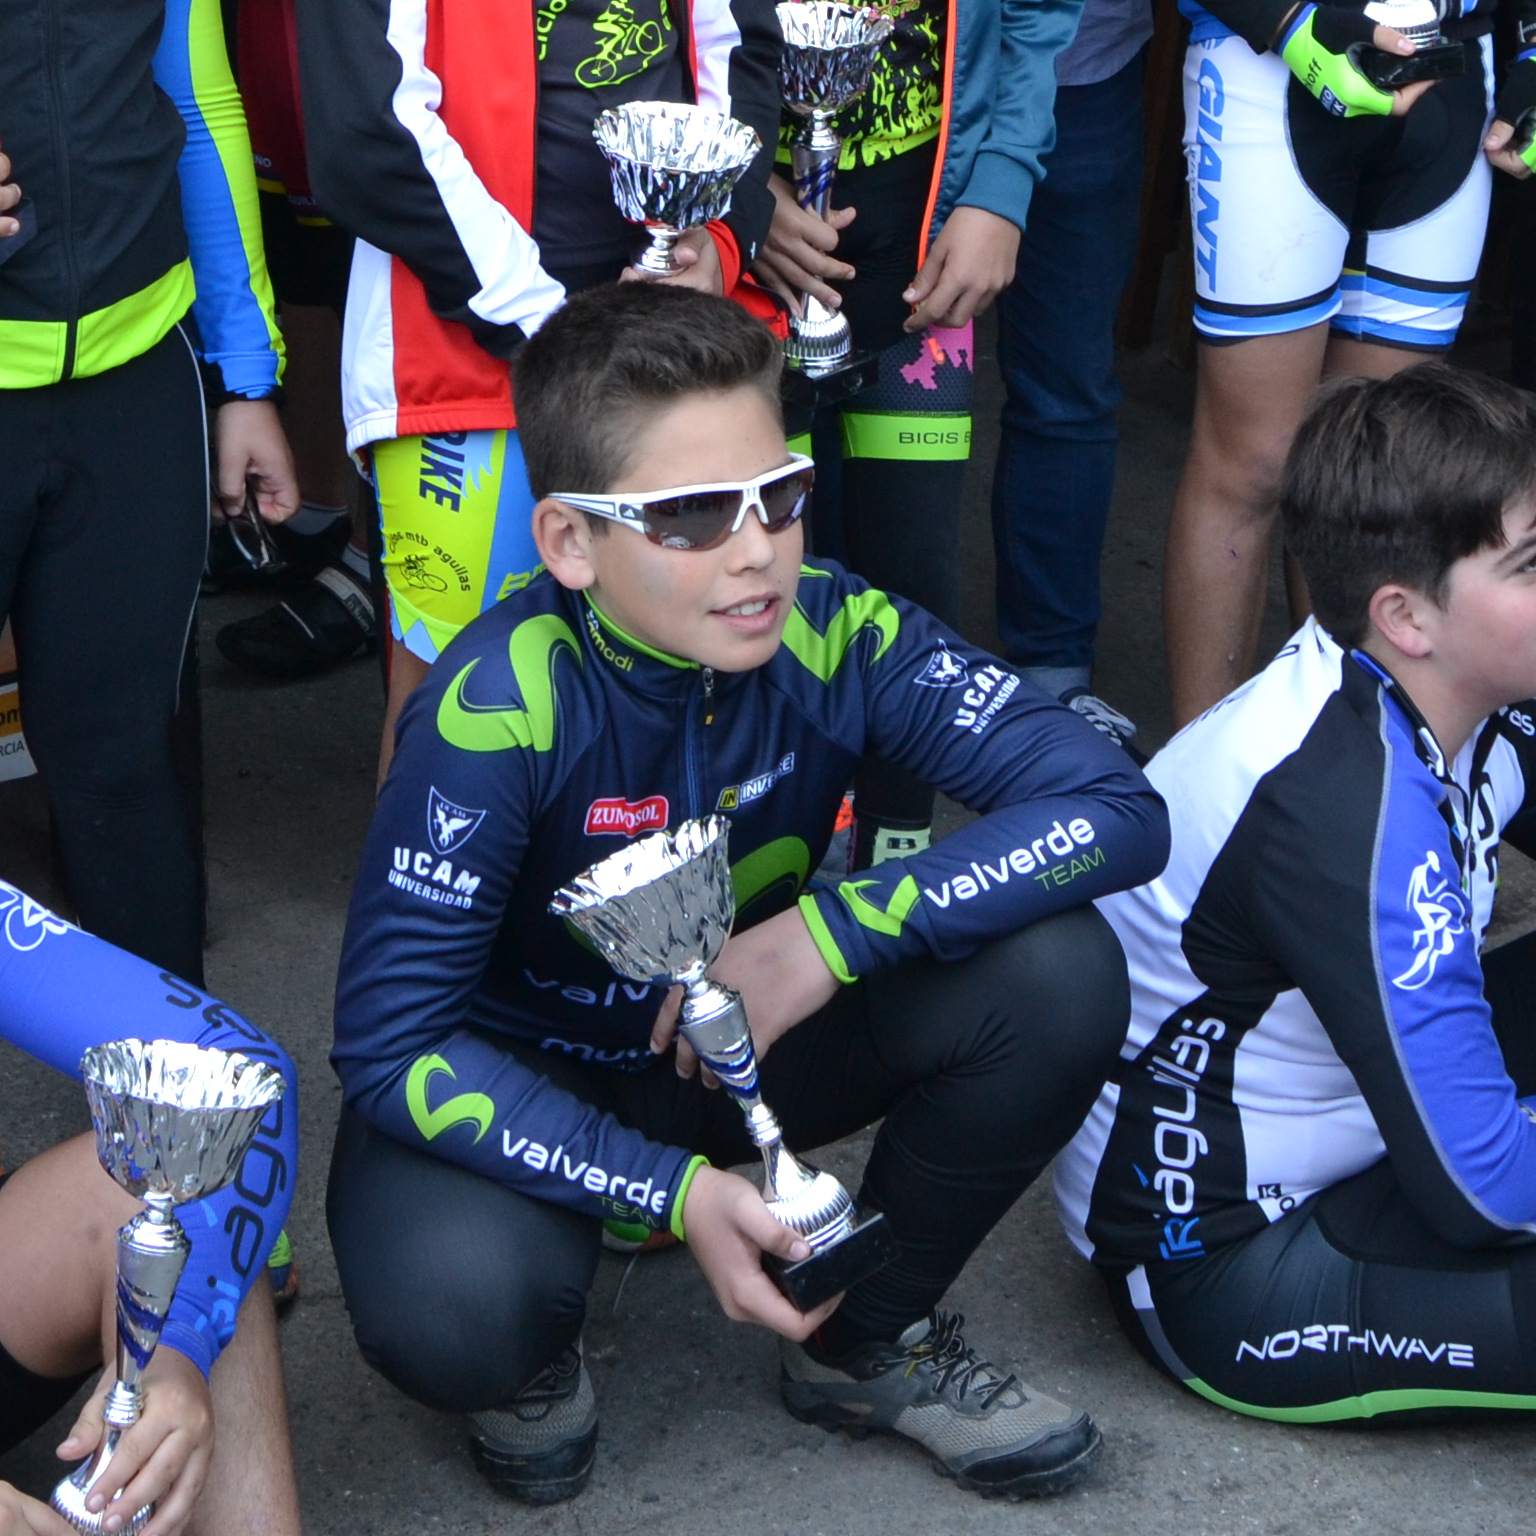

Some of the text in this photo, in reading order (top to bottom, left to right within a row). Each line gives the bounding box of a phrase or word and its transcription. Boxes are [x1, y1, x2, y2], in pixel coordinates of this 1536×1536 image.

[1196, 58, 1225, 294] GIANT
[898, 431, 959, 444] BICIS
[405, 530, 429, 547] mtb
[433, 544, 472, 592] aguilas
[393, 846, 482, 895] UCAM
[924, 817, 1096, 909] valverde
[1034, 846, 1106, 891] TEAM
[387, 868, 473, 911] UNIVERSIDAD
[523, 968, 652, 1008] valv
[503, 1128, 668, 1214] valverde
[1236, 1324, 1475, 1368] NORTHWAVE
